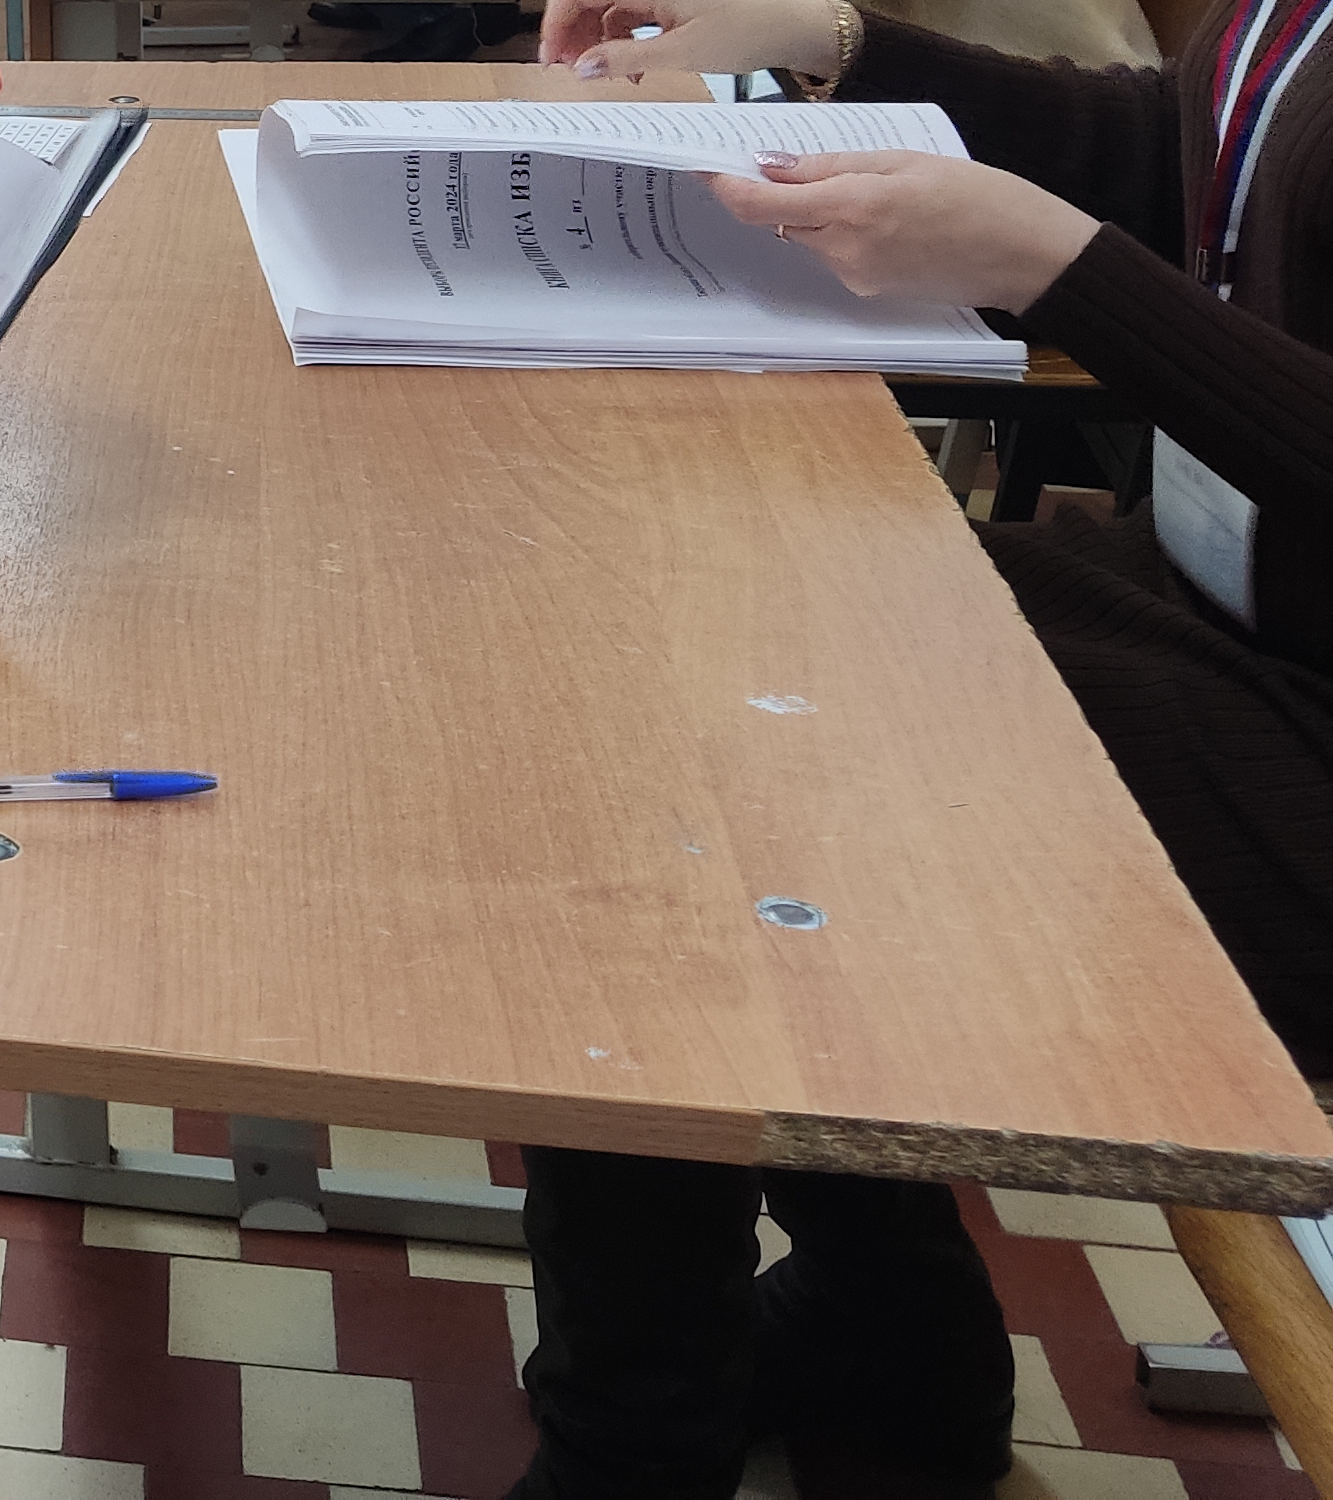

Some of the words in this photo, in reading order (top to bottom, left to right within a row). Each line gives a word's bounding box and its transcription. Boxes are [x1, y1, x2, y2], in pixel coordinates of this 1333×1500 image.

[447, 152, 460, 180] года
[645, 168, 659, 190] окр
[403, 150, 423, 227] РОССИЙ
[445, 184, 459, 213] 2024
[450, 215, 465, 242] марта
[512, 211, 550, 262] СПИСКА
[535, 263, 570, 289] КНИГА
